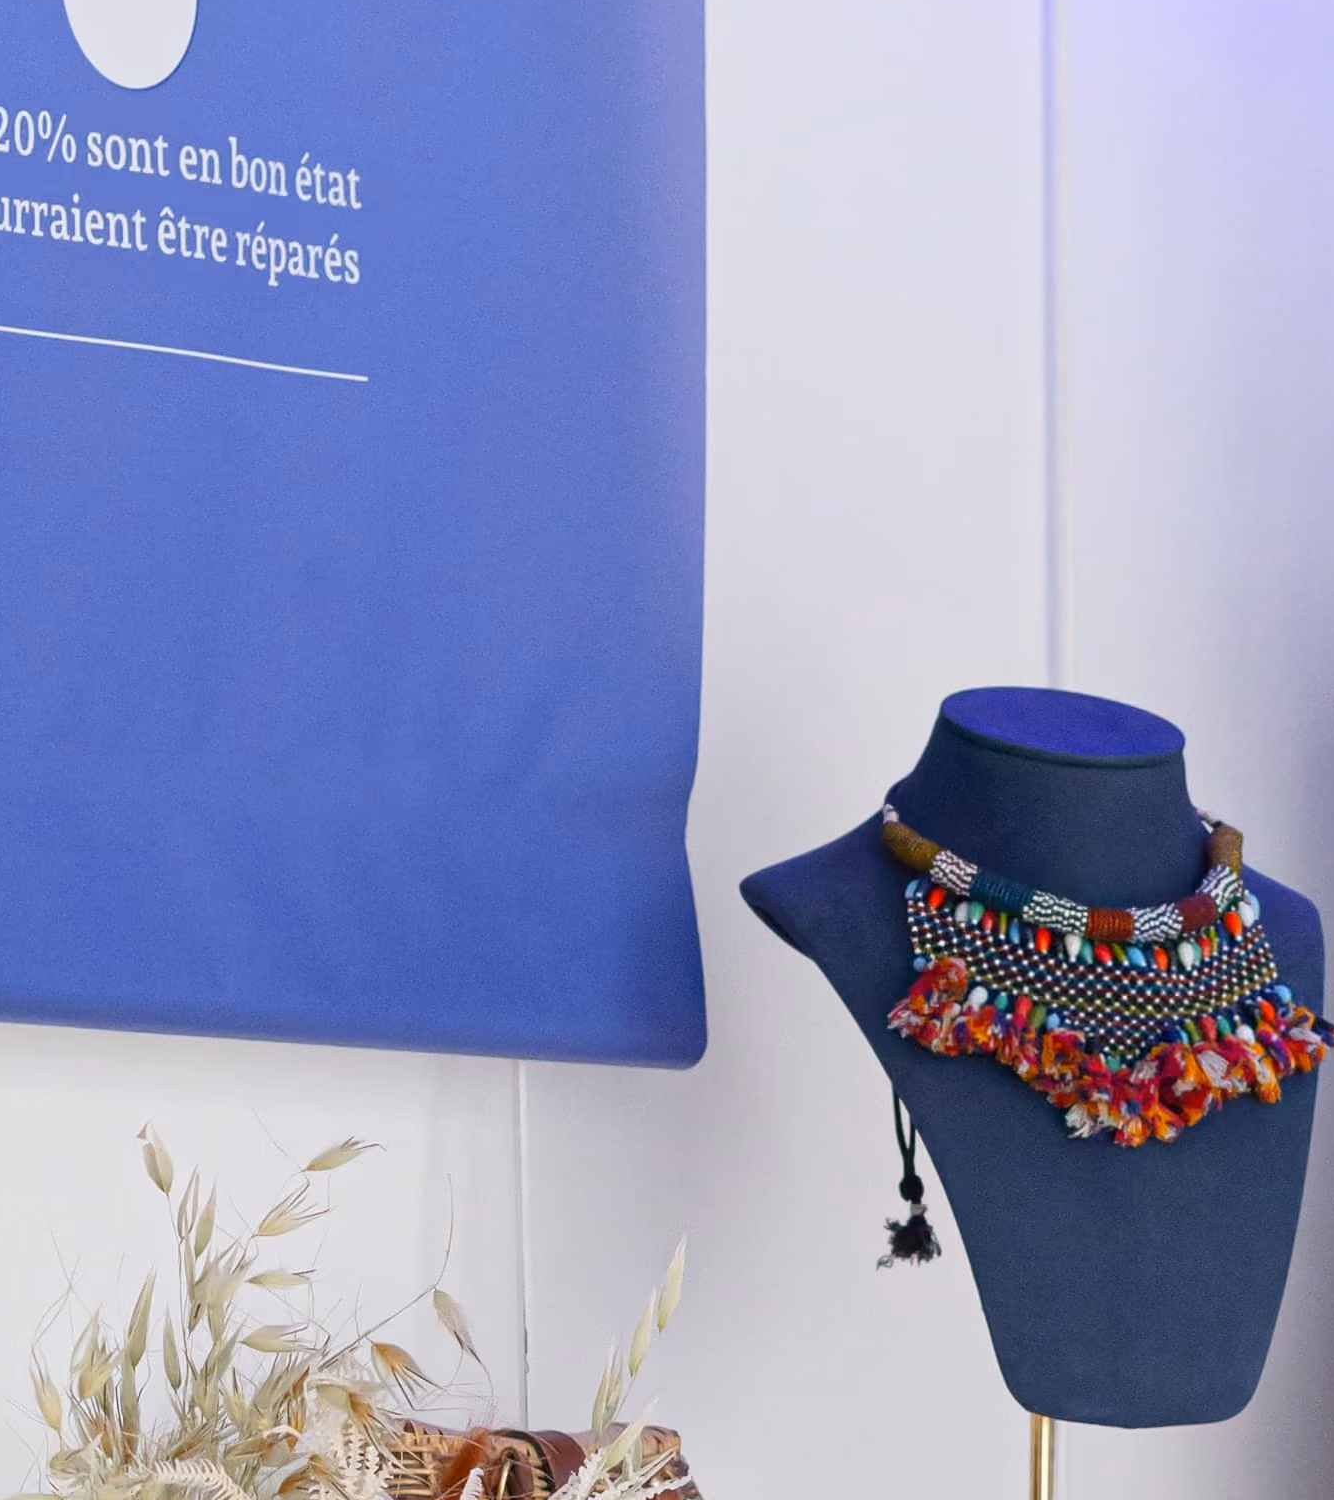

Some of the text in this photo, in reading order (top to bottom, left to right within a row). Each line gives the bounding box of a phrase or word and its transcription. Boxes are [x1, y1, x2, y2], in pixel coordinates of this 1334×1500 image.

[87, 131, 170, 177] sont
[179, 145, 223, 185] en
[228, 136, 288, 197] bon
[295, 152, 362, 210] état
[157, 206, 228, 263] être
[235, 221, 360, 287] réparés
